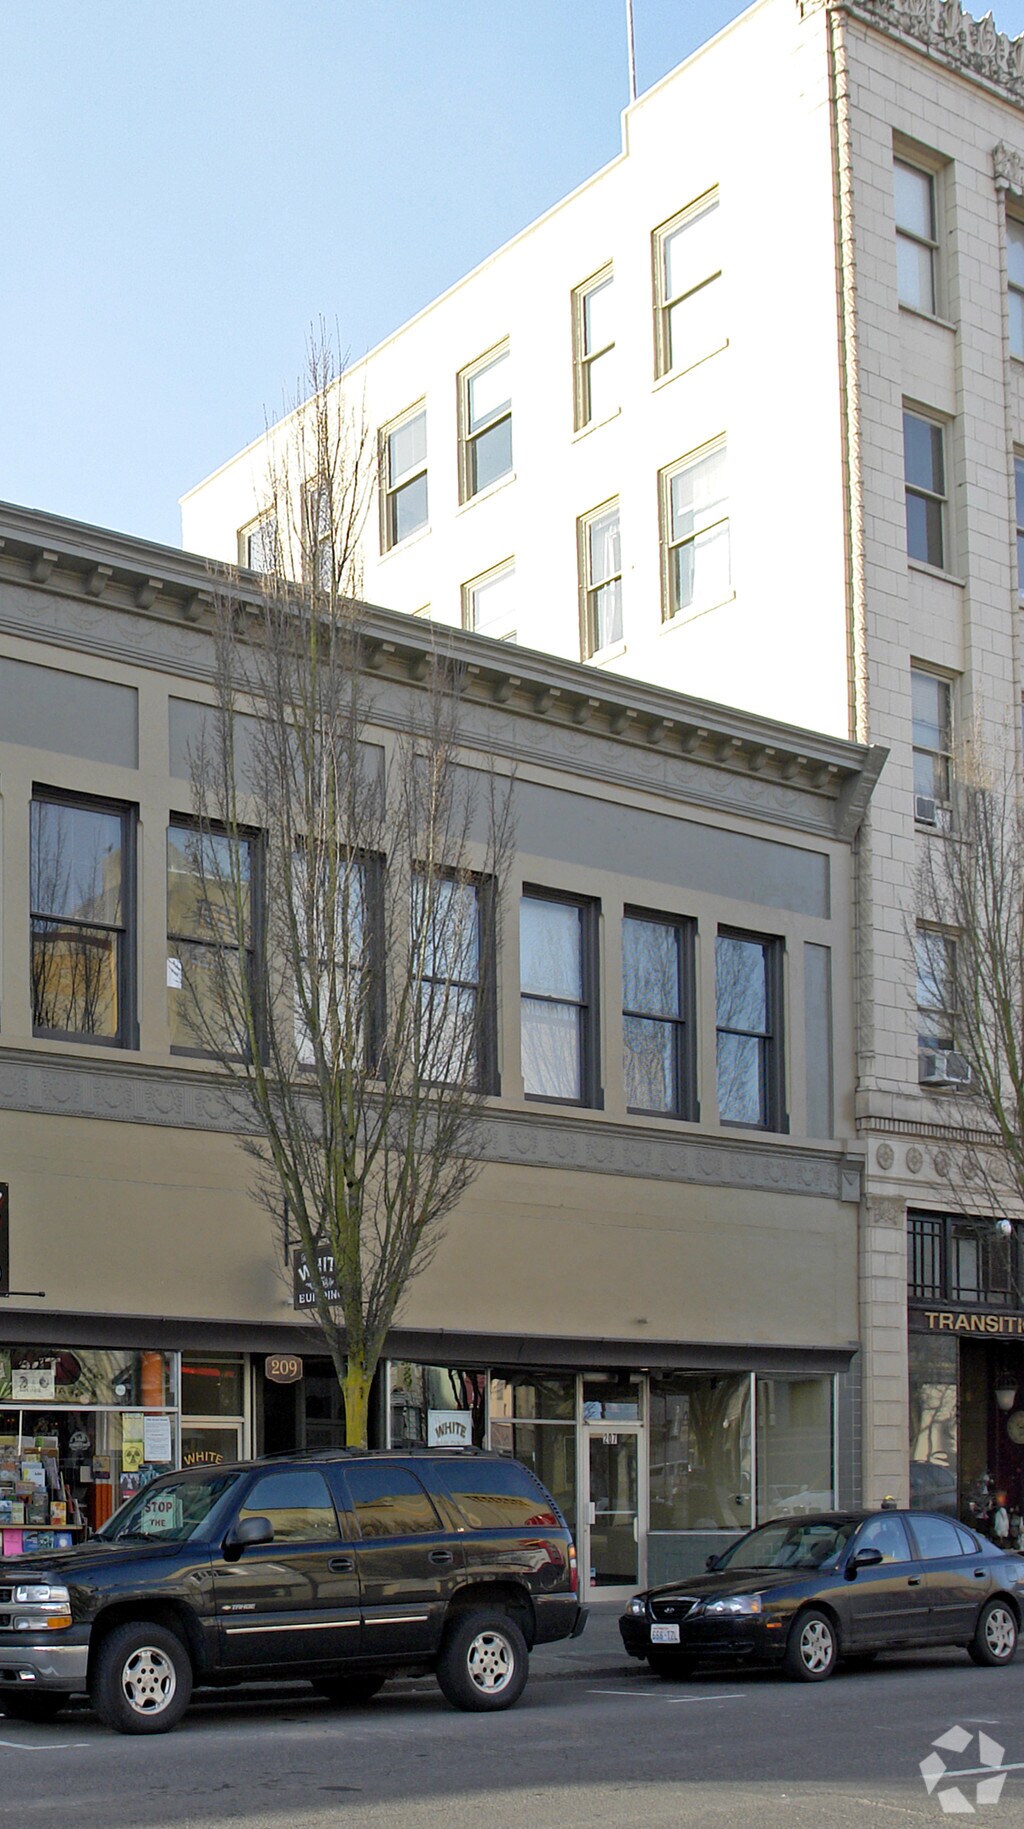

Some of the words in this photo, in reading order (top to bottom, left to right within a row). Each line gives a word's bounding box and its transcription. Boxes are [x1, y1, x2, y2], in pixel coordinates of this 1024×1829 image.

[924, 1312, 1024, 1334] TRANSITI
[271, 1359, 298, 1377] 209
[434, 1421, 468, 1439] WHITE
[603, 1432, 618, 1445] 207
[183, 1451, 224, 1465] WHITE
[144, 1501, 173, 1513] STOP
[150, 1519, 166, 1527] THE
